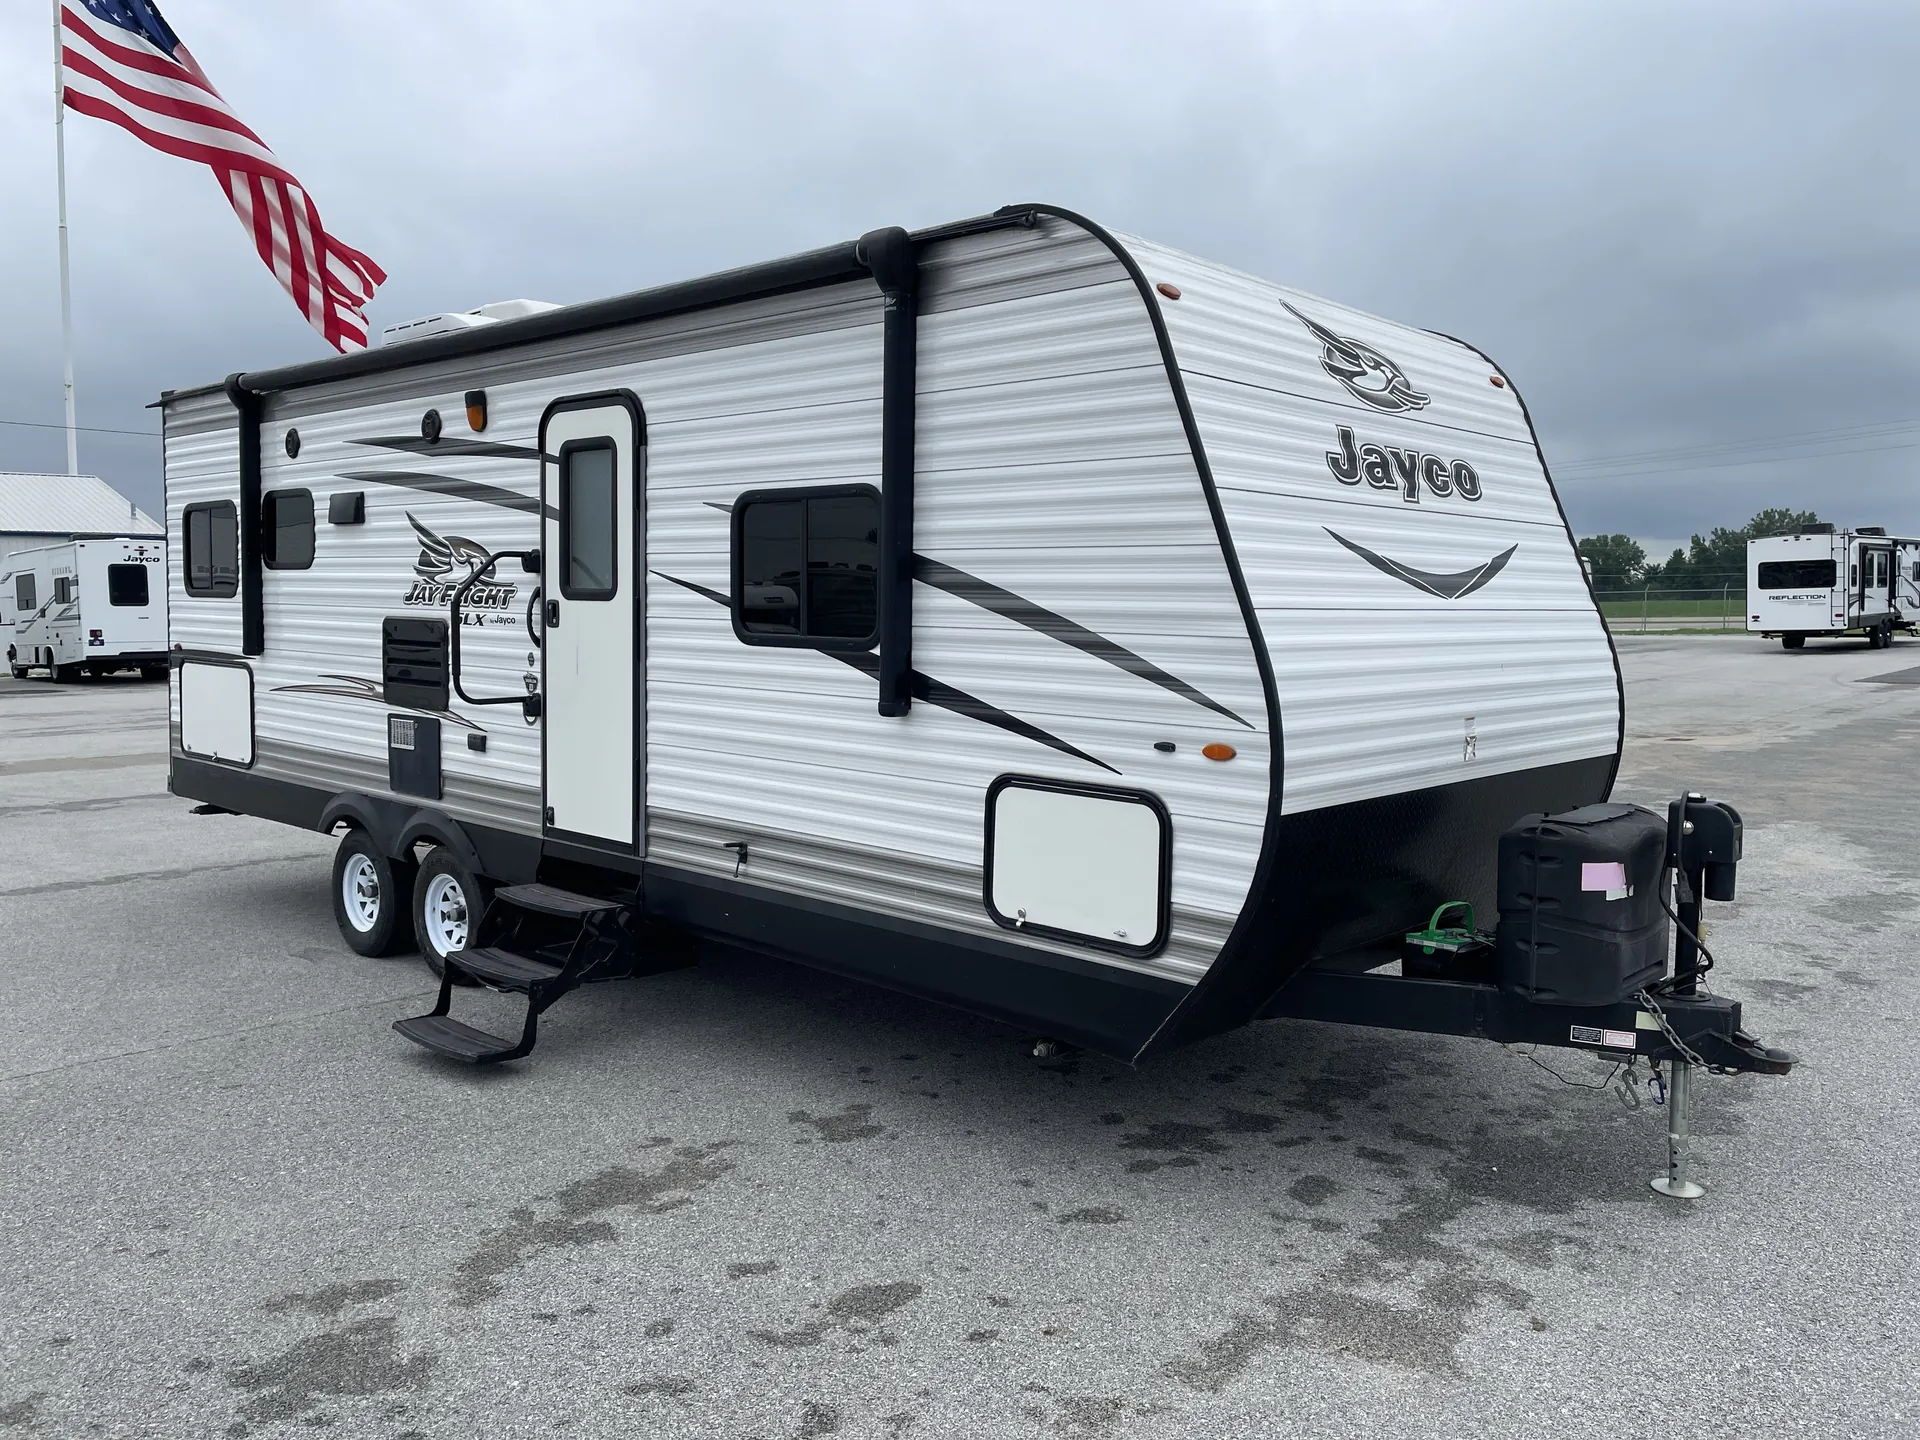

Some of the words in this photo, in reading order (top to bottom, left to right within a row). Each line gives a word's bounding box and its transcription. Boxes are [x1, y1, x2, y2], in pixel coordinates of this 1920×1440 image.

[1326, 424, 1483, 504] Jayco
[123, 555, 160, 564] Jayco
[403, 581, 442, 606] JAY
[439, 582, 518, 609] FIGHT
[494, 614, 516, 626] Jayco
